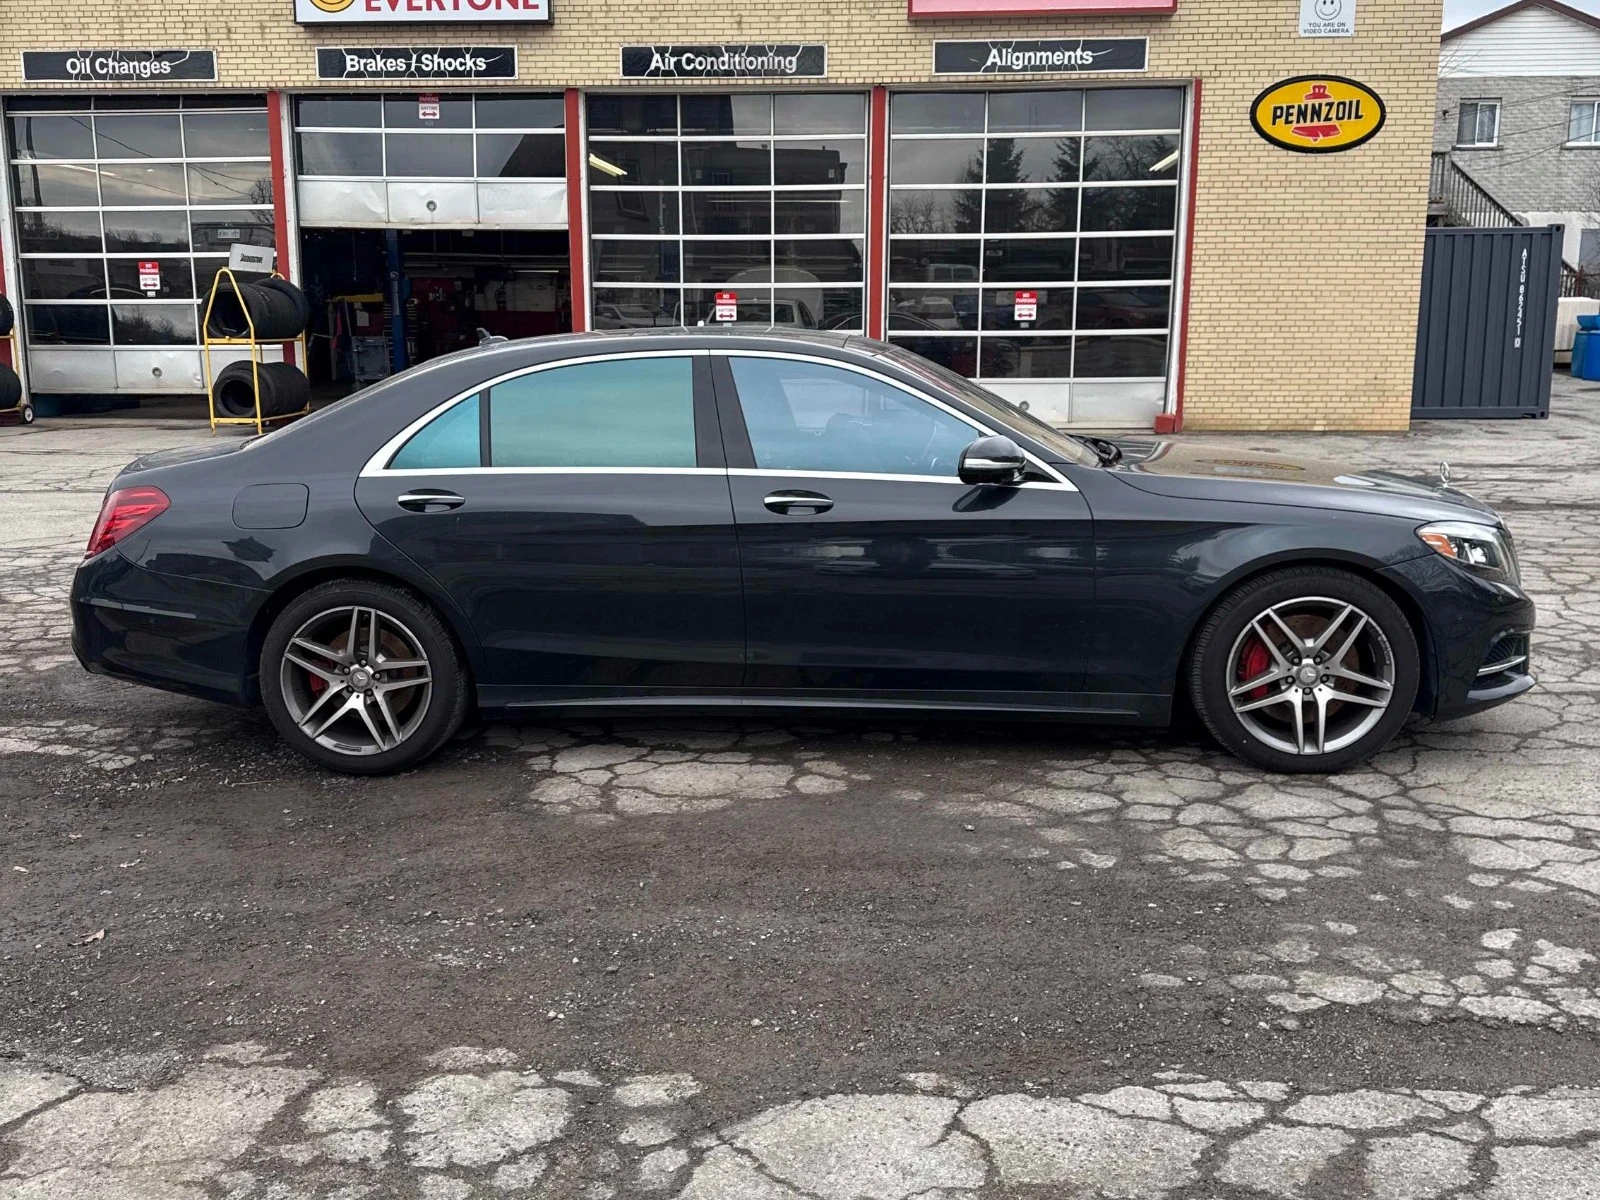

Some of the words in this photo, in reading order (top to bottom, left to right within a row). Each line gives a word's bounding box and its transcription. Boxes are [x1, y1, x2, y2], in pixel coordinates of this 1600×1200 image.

[66, 57, 91, 75] Oil
[95, 57, 171, 78] Changes
[345, 54, 407, 72] Brakes
[420, 53, 487, 72] Shocks
[649, 52, 678, 71] Air
[681, 52, 798, 74] Conditioning
[985, 47, 1094, 70] Alignments
[1271, 99, 1364, 126] PENNZOIL
